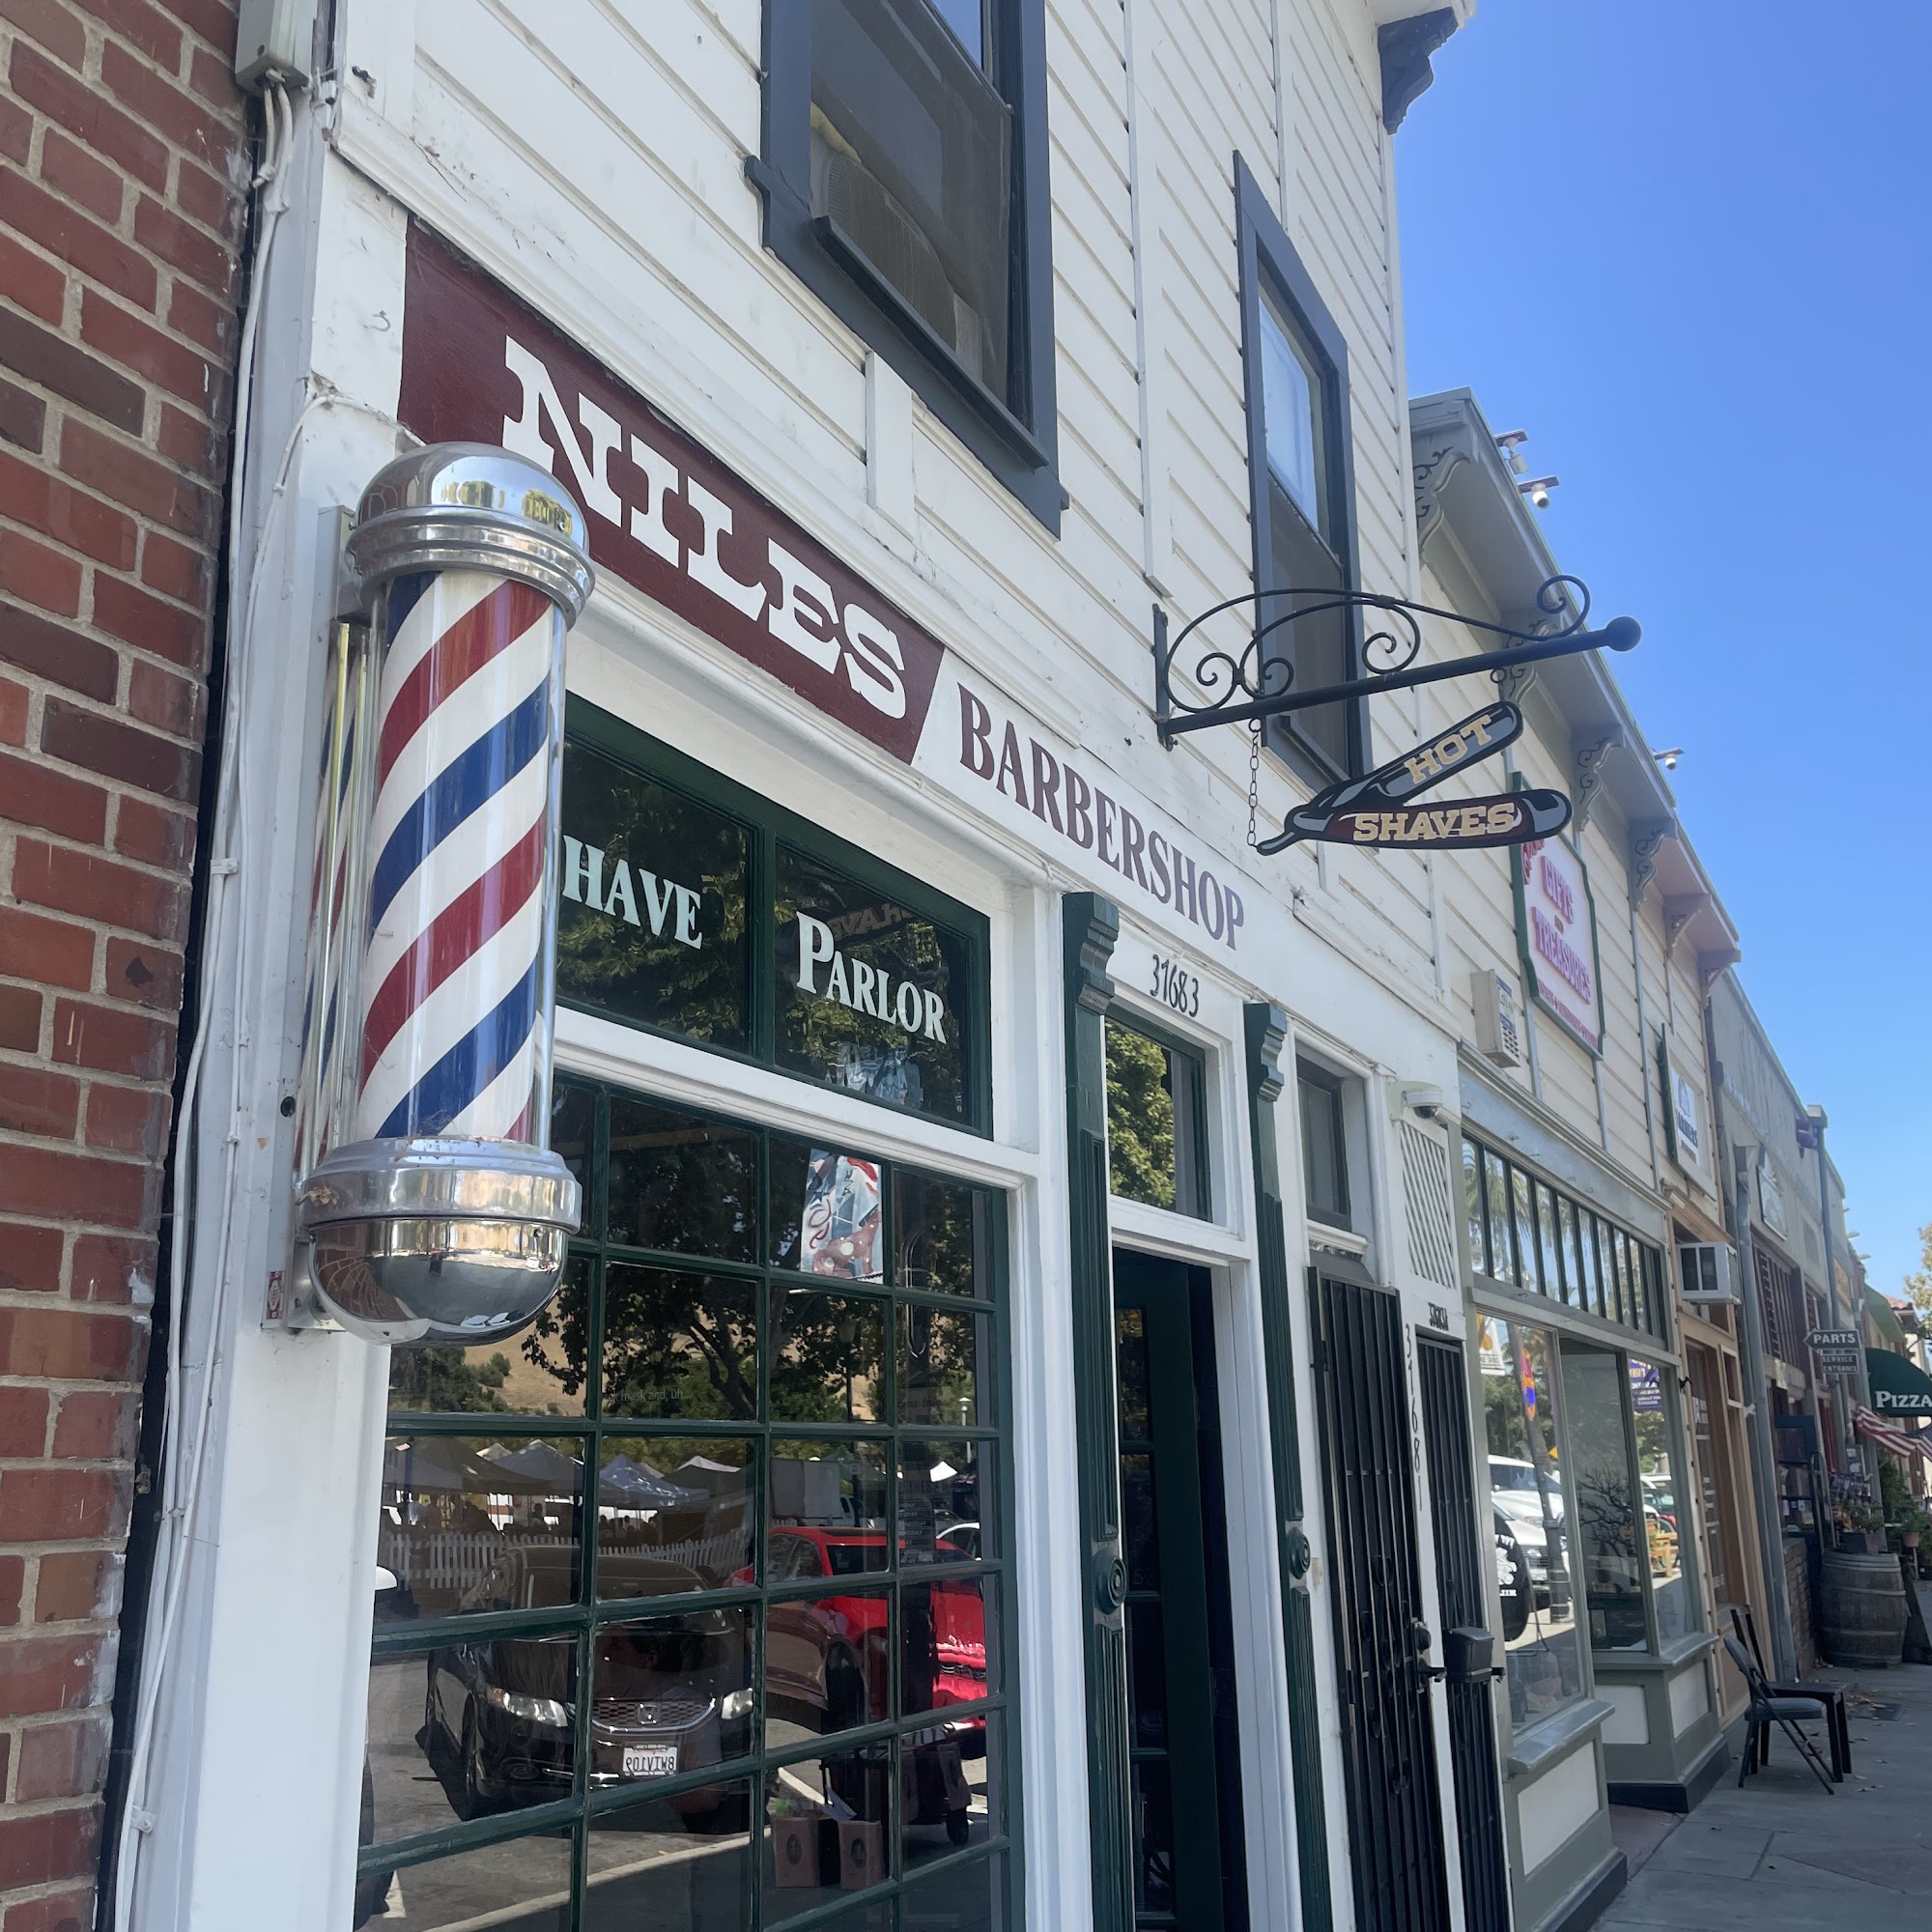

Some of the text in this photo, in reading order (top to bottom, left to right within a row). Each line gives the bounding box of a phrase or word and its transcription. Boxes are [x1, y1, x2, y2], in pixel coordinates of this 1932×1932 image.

[502, 334, 906, 719] NILES
[1404, 715, 1492, 784] HOT
[957, 682, 1244, 951] BARBERSHOP
[1353, 803, 1515, 841] SHAVES
[562, 836, 947, 1044] HAVE PARLOR
[1532, 907, 1590, 1005] TREASURES
[1150, 954, 1199, 1017] 31683
[1813, 1334, 1856, 1344] PARTS
[1406, 1322, 1422, 1512] 31681
[1875, 1391, 1932, 1408] PIZZA
